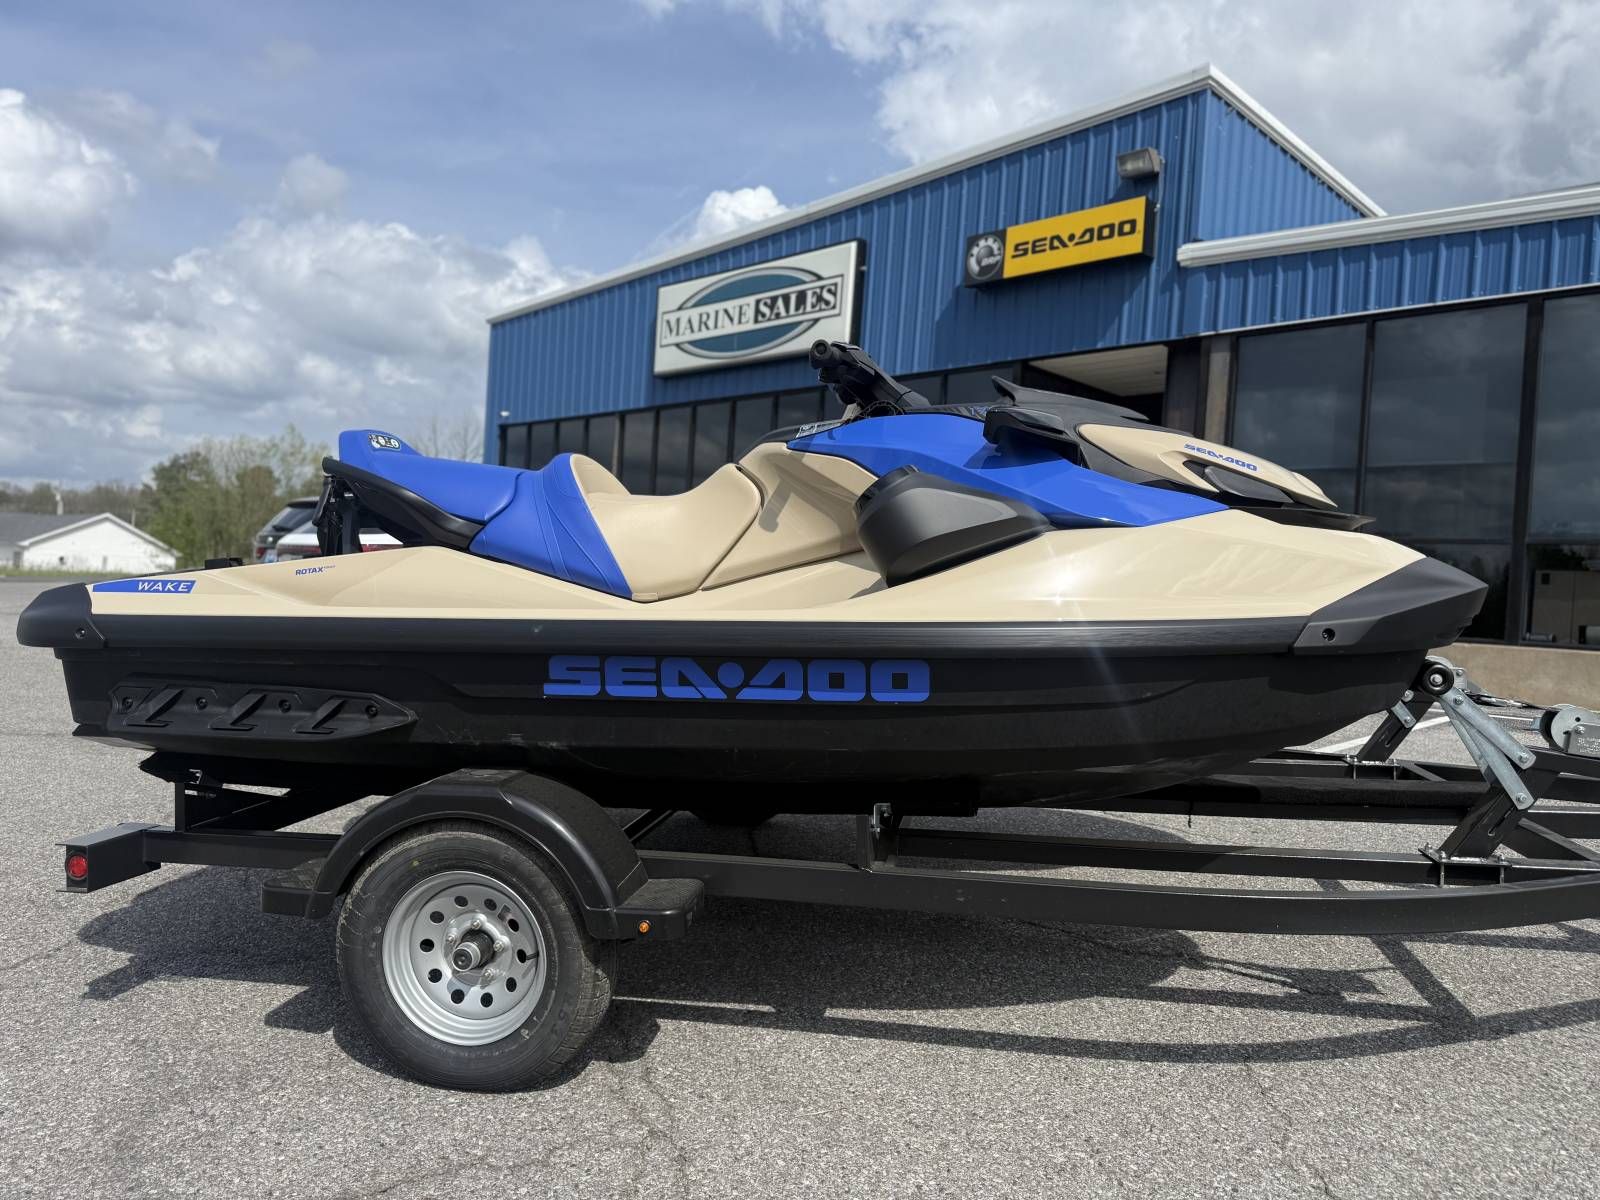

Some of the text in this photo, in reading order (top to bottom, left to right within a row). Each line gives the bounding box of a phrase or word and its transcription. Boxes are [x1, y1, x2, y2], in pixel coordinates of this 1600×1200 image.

[663, 284, 836, 339] MARINE SALES
[295, 567, 323, 575] ROTAX
[138, 581, 191, 591] WAKE
